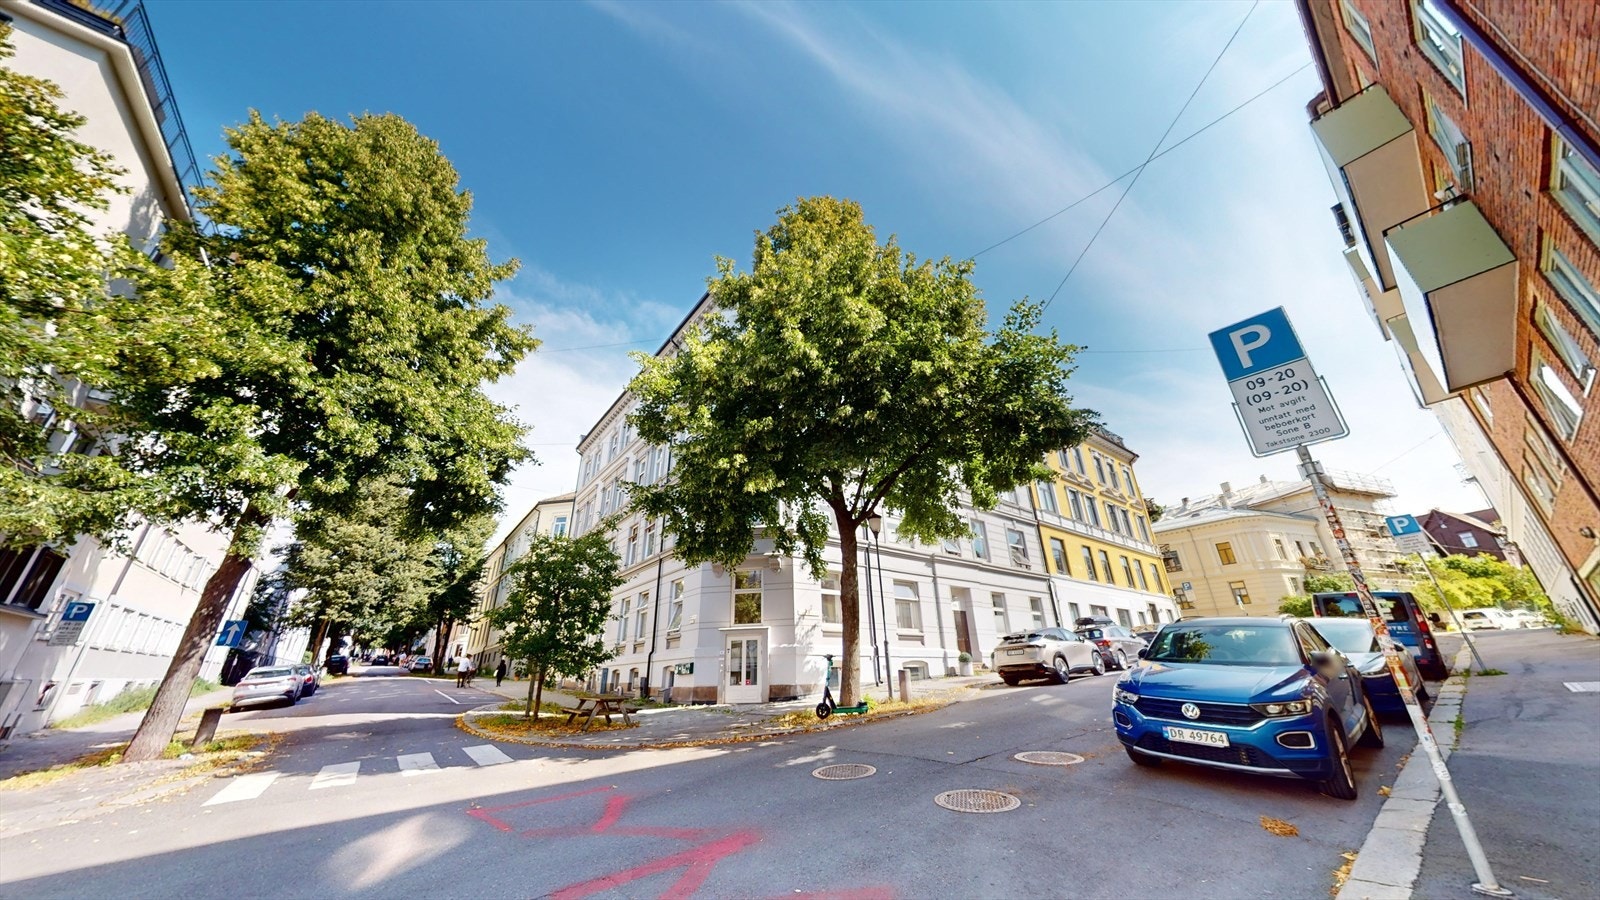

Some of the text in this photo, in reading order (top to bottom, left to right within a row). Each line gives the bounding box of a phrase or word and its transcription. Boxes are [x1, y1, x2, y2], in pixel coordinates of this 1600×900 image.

[1229, 324, 1272, 369] P
[1258, 396, 1306, 413] Mot avgift
[1259, 404, 1316, 424] unntatt med
[1264, 413, 1316, 431] beboerkort
[1265, 427, 1331, 447] Takstsone 2300
[1276, 426, 1299, 436] Sone
[1391, 517, 1409, 534] P
[69, 605, 88, 619] P
[1170, 728, 1225, 744] DR 49764
